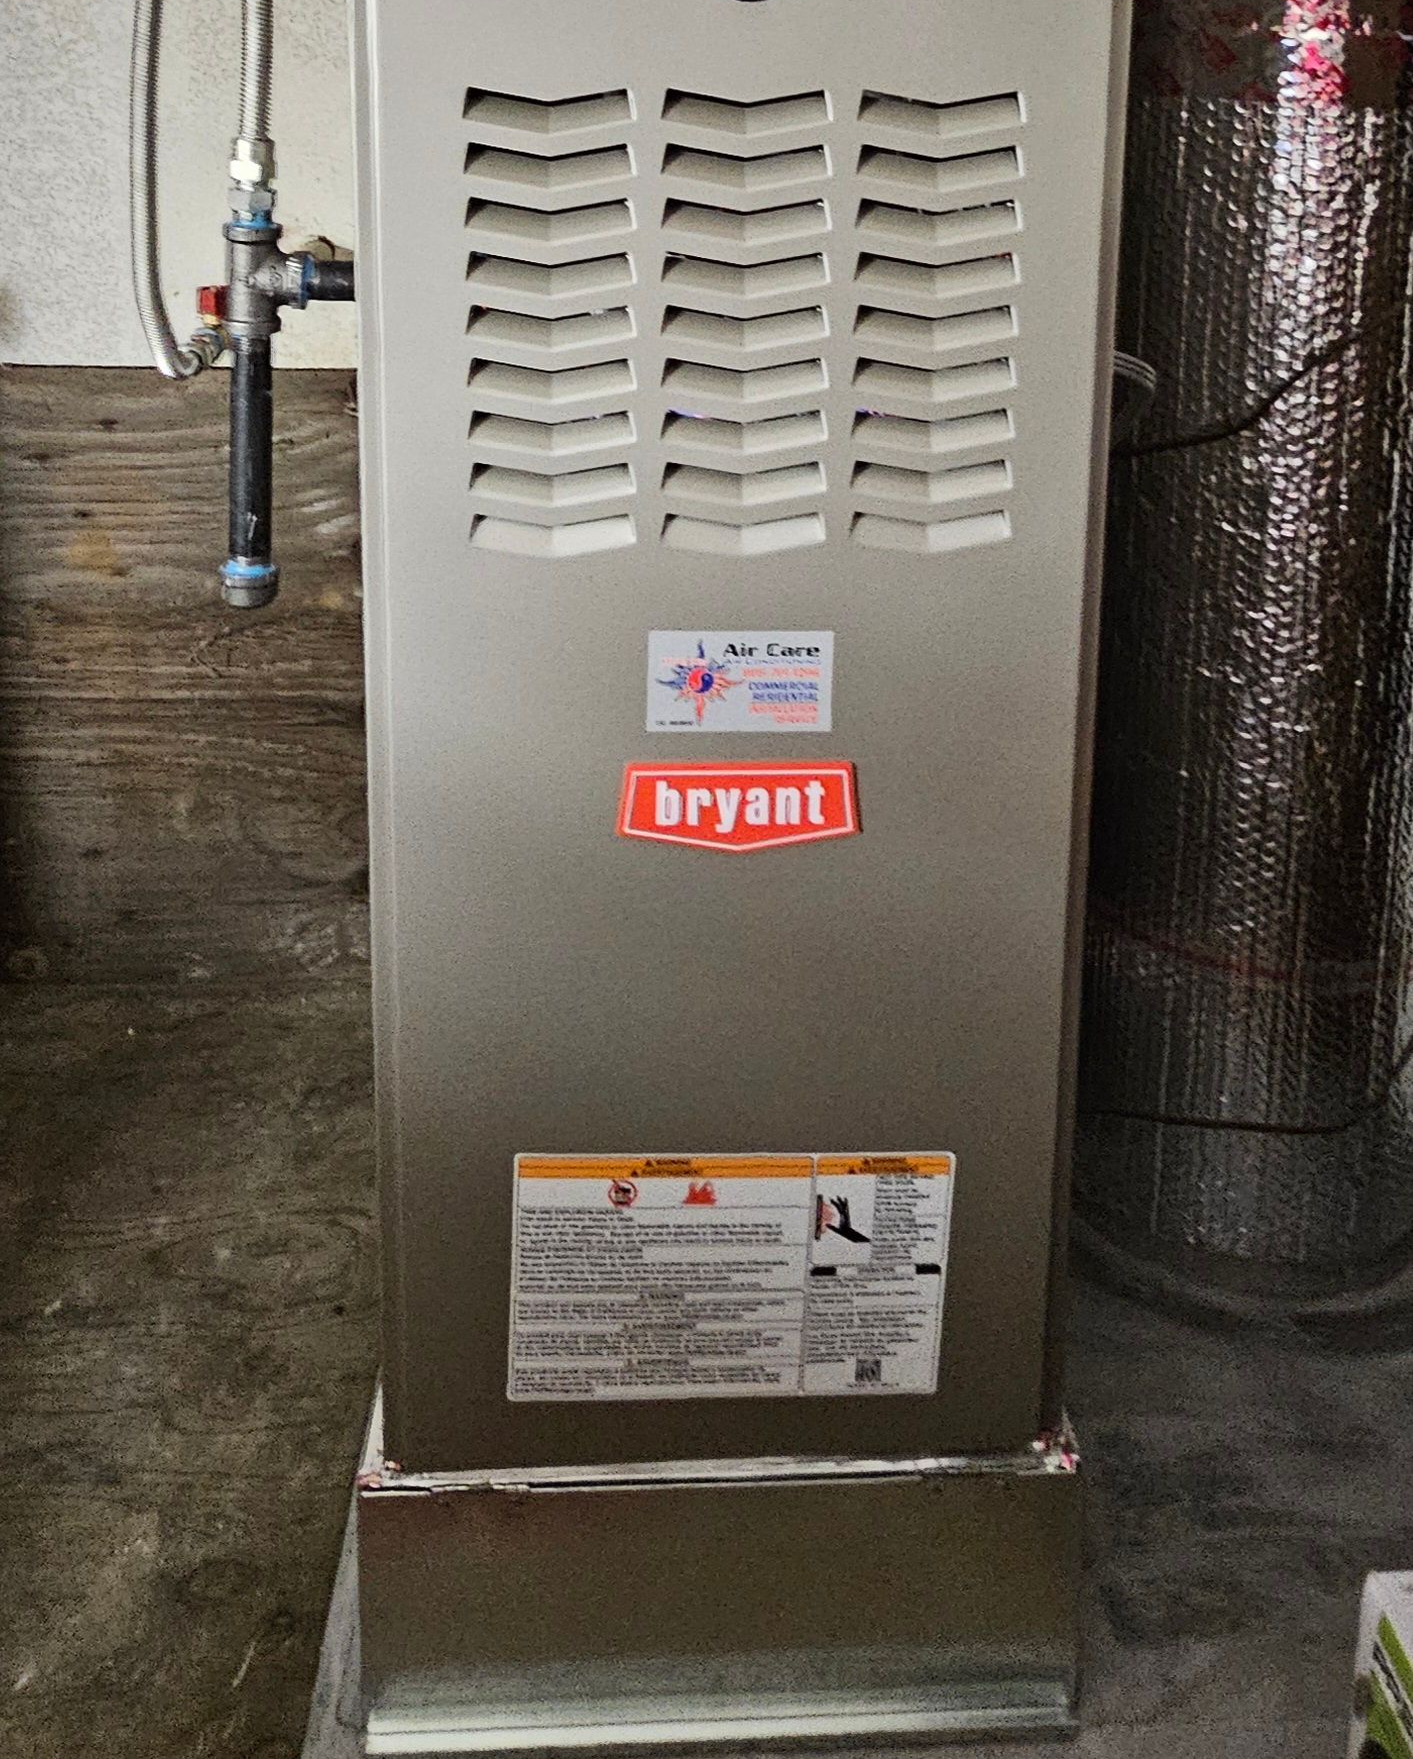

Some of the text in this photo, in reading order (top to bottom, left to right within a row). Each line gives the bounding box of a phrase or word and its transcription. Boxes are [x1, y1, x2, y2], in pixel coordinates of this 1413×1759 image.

[723, 642, 821, 658] Air Care
[655, 779, 826, 834] bryant
